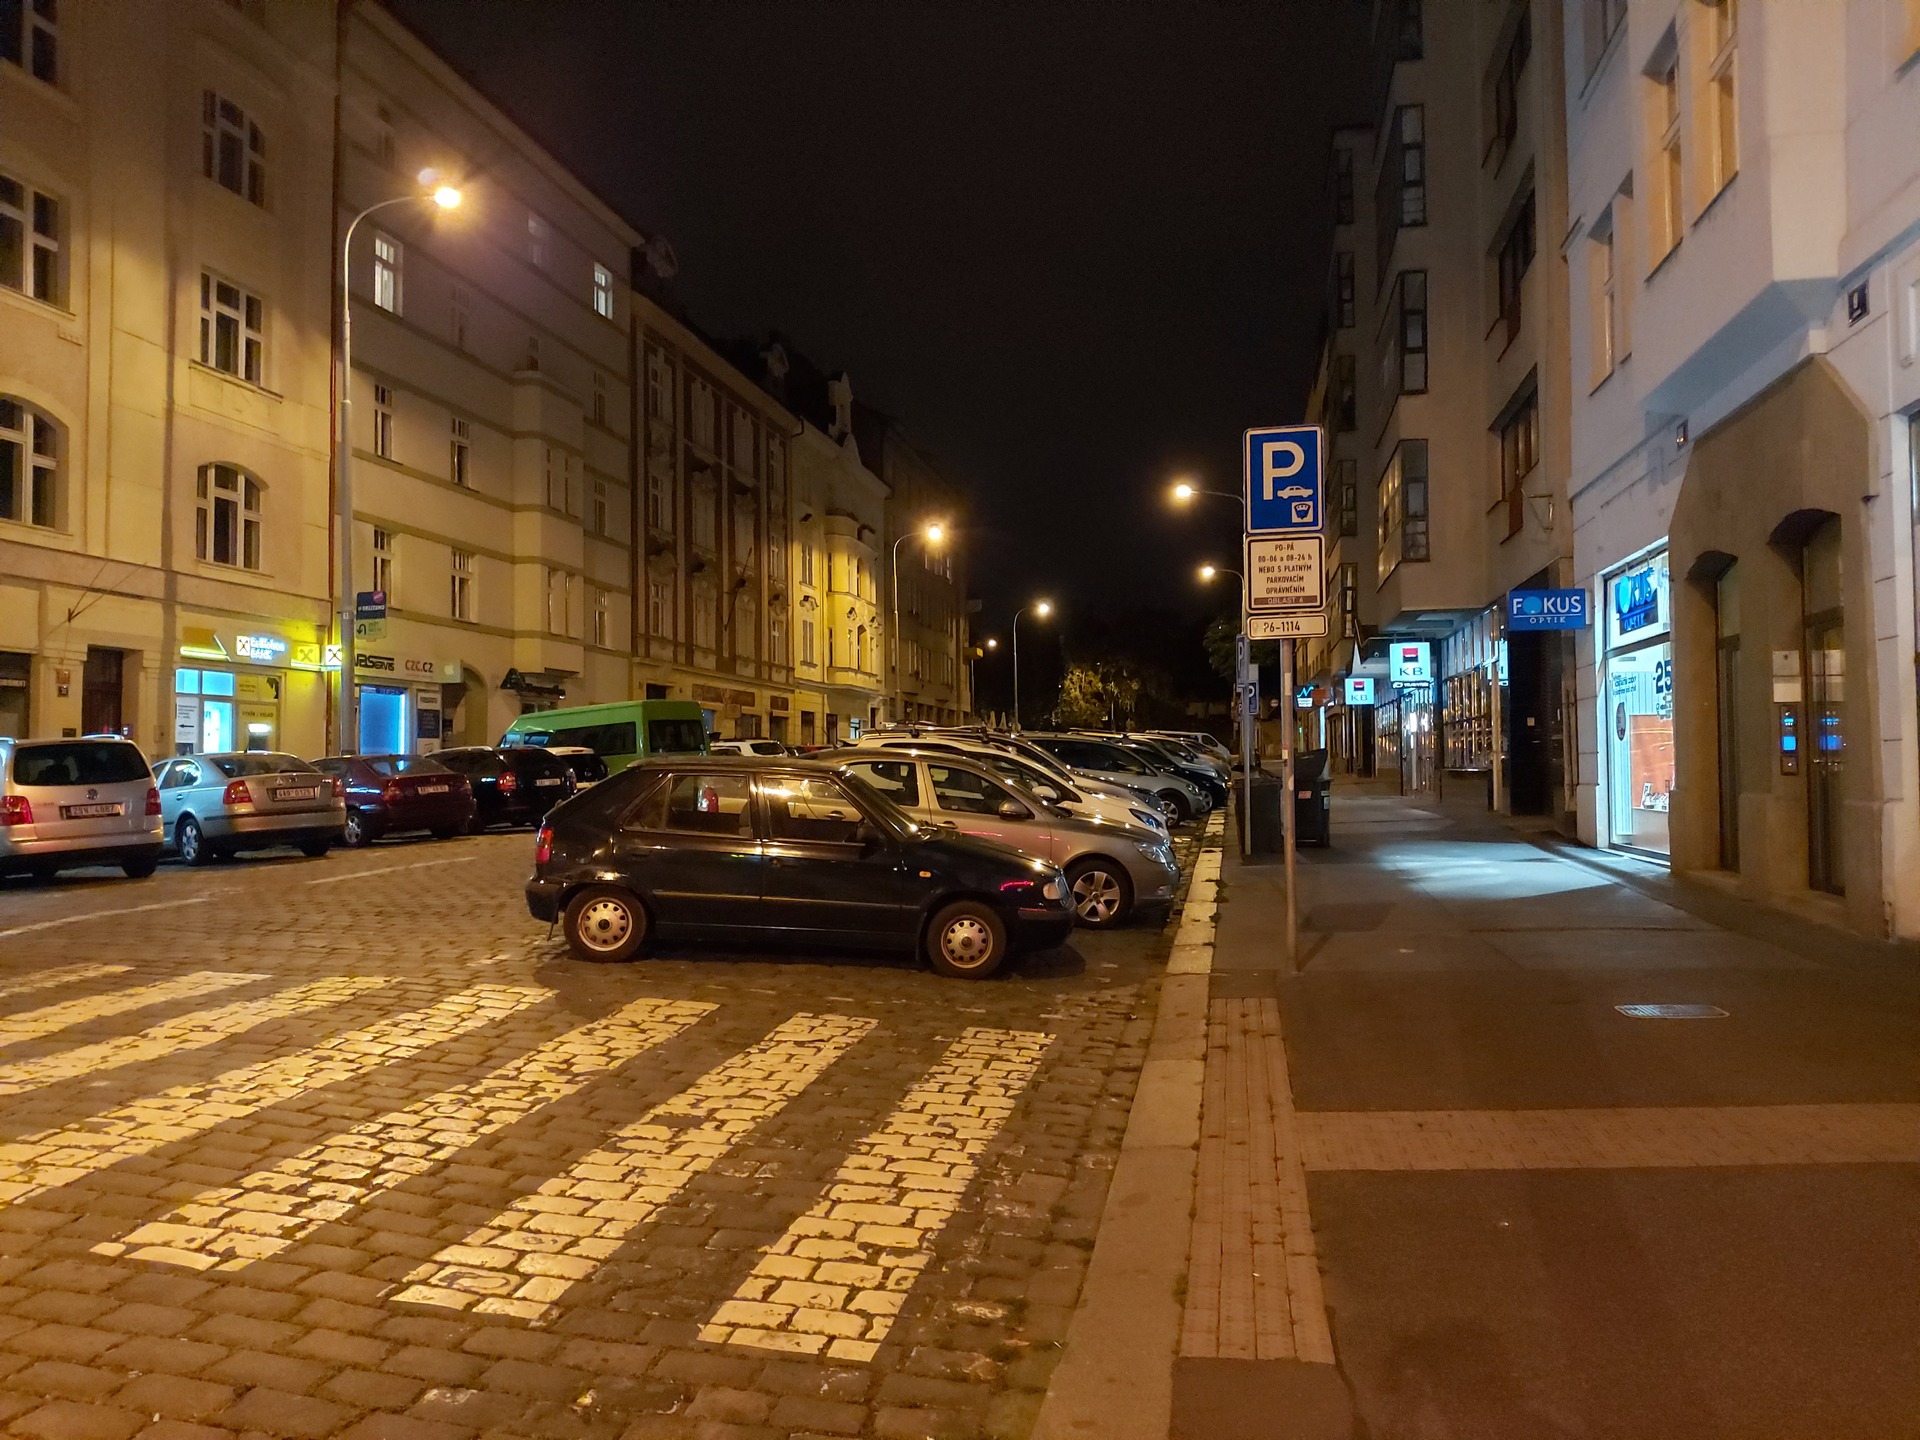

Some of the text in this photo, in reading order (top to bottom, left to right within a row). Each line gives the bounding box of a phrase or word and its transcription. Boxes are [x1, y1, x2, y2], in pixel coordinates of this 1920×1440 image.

[1262, 441, 1305, 501] P
[1274, 542, 1295, 551] PO-PÁ
[1307, 553, 1313, 561] h
[1258, 562, 1312, 574] NEBO S PLATNÝM
[1266, 574, 1304, 584] PARKOVACÍM
[1265, 585, 1306, 595] OPRÁVNĚNÍM
[1267, 597, 1296, 605] OBLAST
[1512, 596, 1582, 615] FOKUS
[1529, 616, 1566, 624] OPTIK
[1263, 620, 1301, 633] P6-1114
[405, 659, 434, 673] CZC.CZ
[1399, 667, 1423, 676] KB
